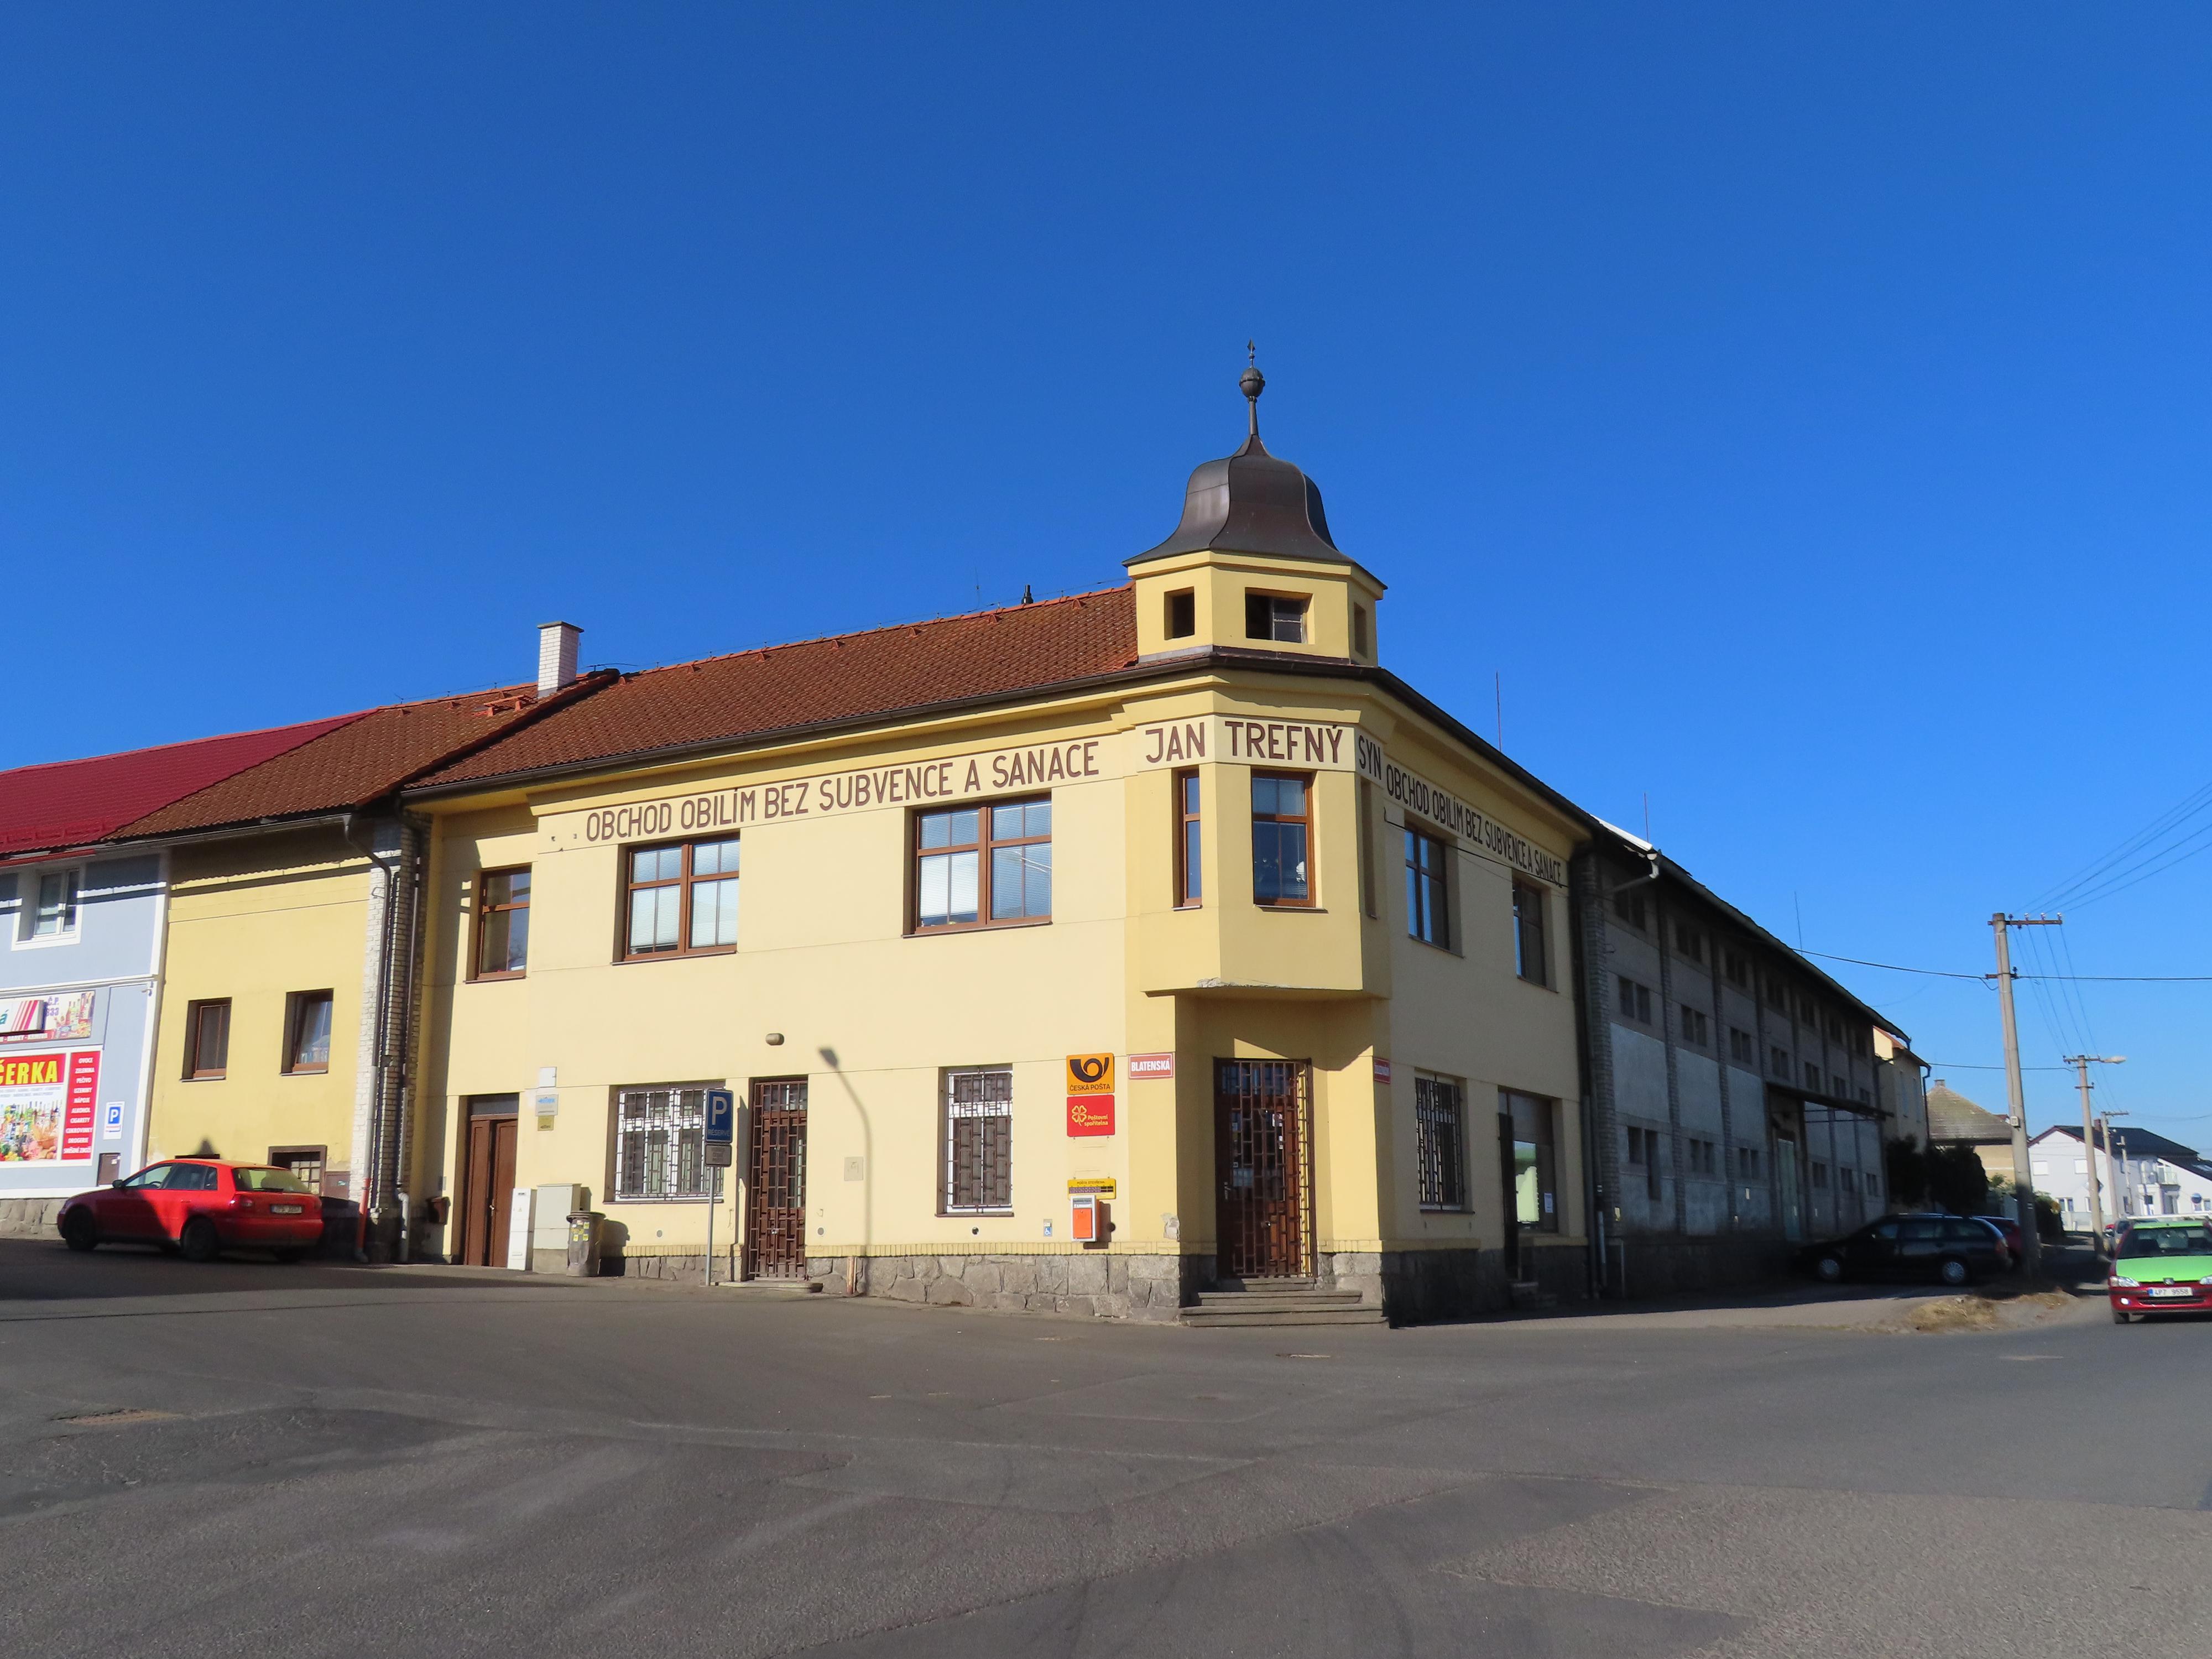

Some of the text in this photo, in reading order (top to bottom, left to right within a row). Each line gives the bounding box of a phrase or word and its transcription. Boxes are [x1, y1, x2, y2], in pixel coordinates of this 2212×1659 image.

[1145, 721, 1381, 780] JAN TREFNÝ SYN
[586, 742, 1099, 842] OBCHOD OBILÍM BEZ SUBVENCE A SANACE
[1386, 764, 1562, 888] OBCHOD OBILÍM BEZ SUBVENCE A SANACE
[1131, 1058, 1171, 1072] BLATENSKÁ
[110, 1109, 119, 1122] P
[711, 1095, 728, 1125] P
